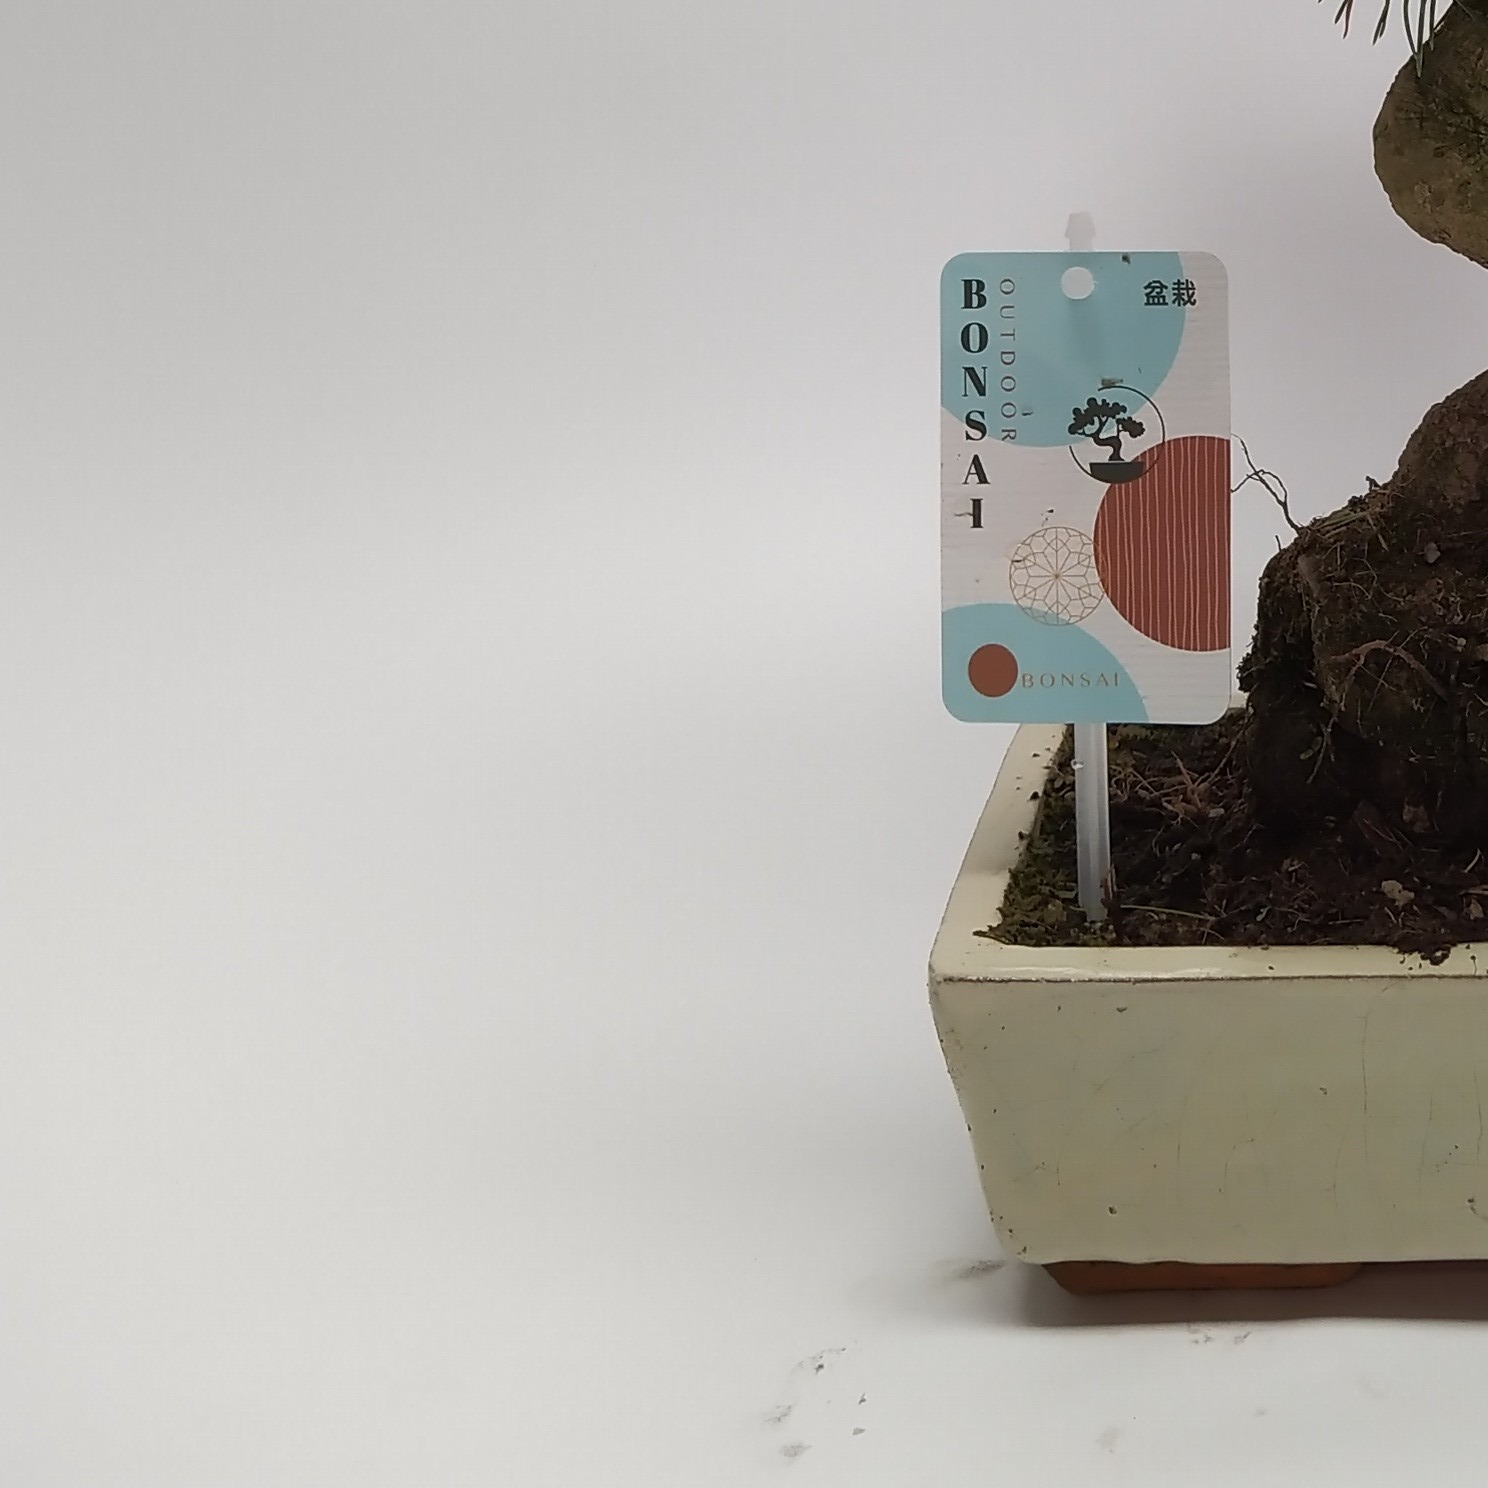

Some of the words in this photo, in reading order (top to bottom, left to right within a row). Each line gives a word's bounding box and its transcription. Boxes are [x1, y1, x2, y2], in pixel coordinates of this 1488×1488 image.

[1143, 279, 1197, 307] 盆栽
[960, 278, 990, 528] BONSAI
[1000, 278, 1015, 442] OUTDOOR
[1022, 672, 1119, 688] BONSAI
